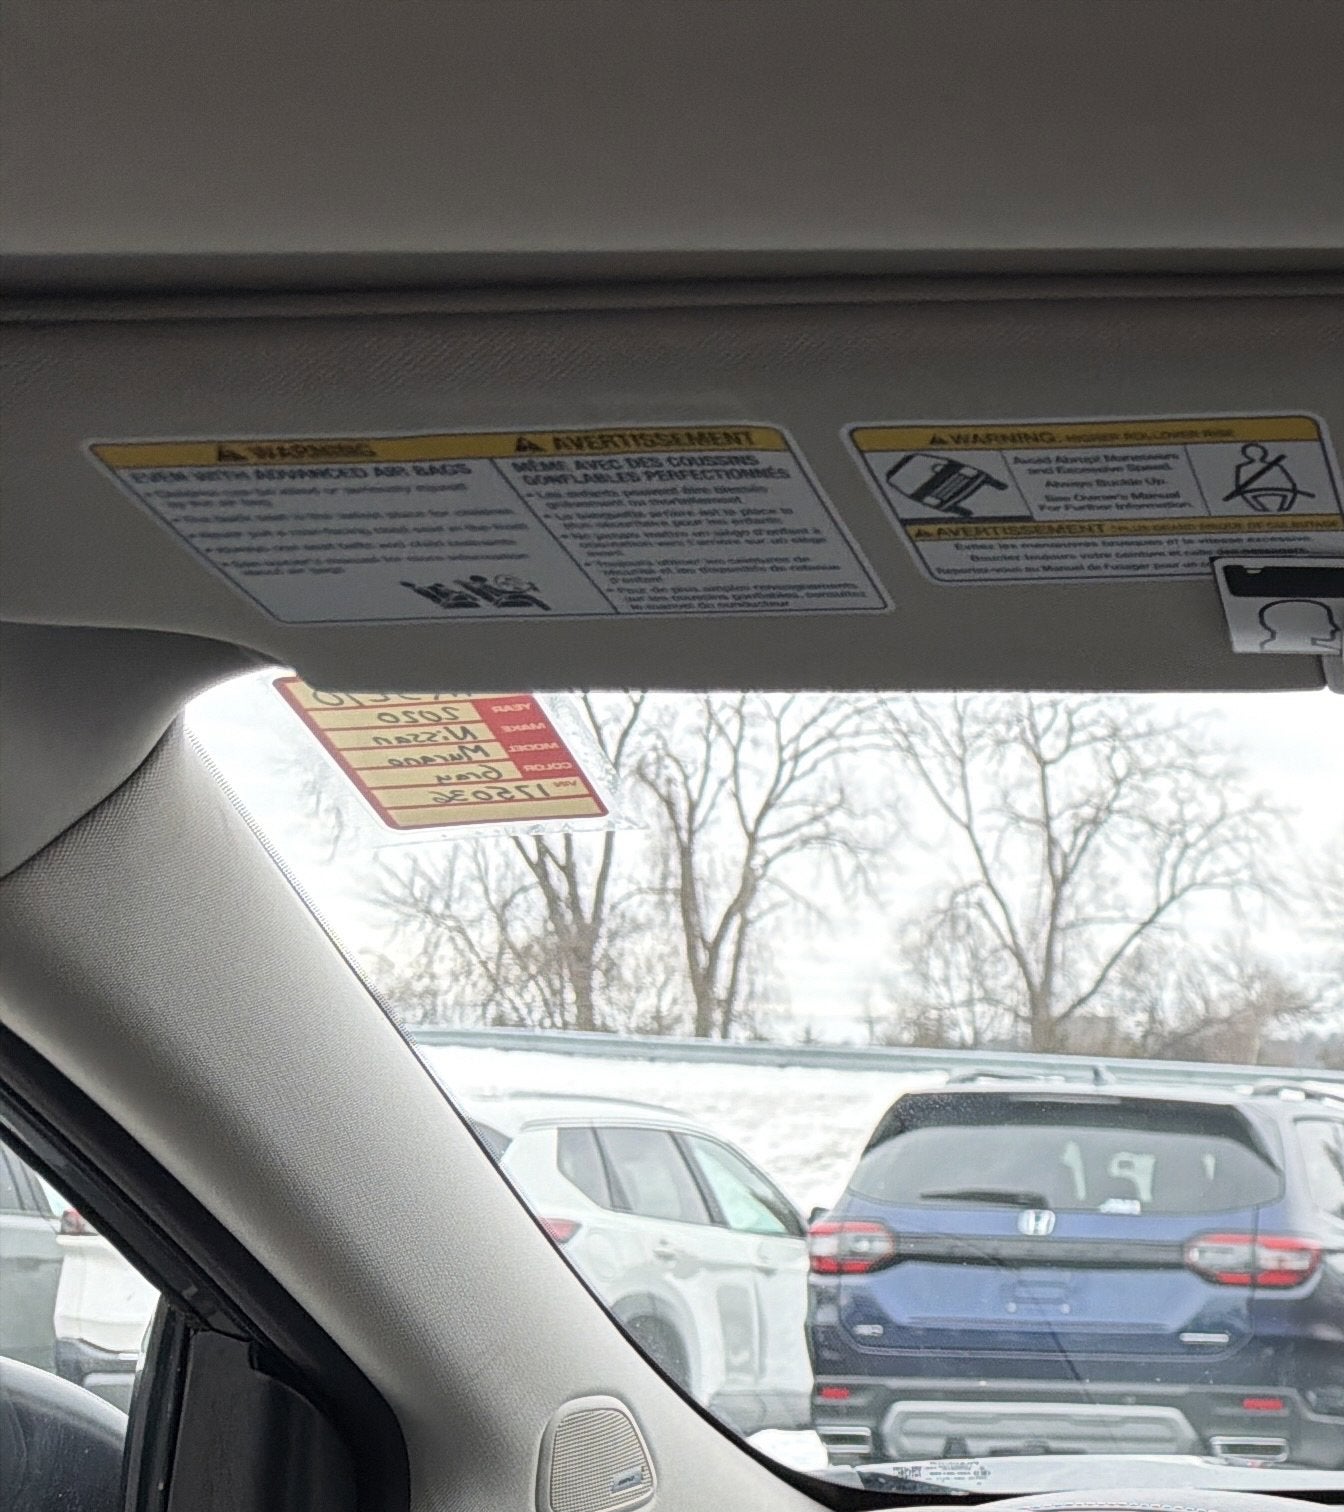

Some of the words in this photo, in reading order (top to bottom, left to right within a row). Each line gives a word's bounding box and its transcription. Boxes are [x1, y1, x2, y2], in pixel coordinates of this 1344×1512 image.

[553, 432, 755, 450] AVERTISSEMENT
[412, 463, 471, 476] BAGS
[576, 458, 621, 470] AVEC
[624, 456, 662, 468] DES
[667, 454, 760, 467] COUSSINS
